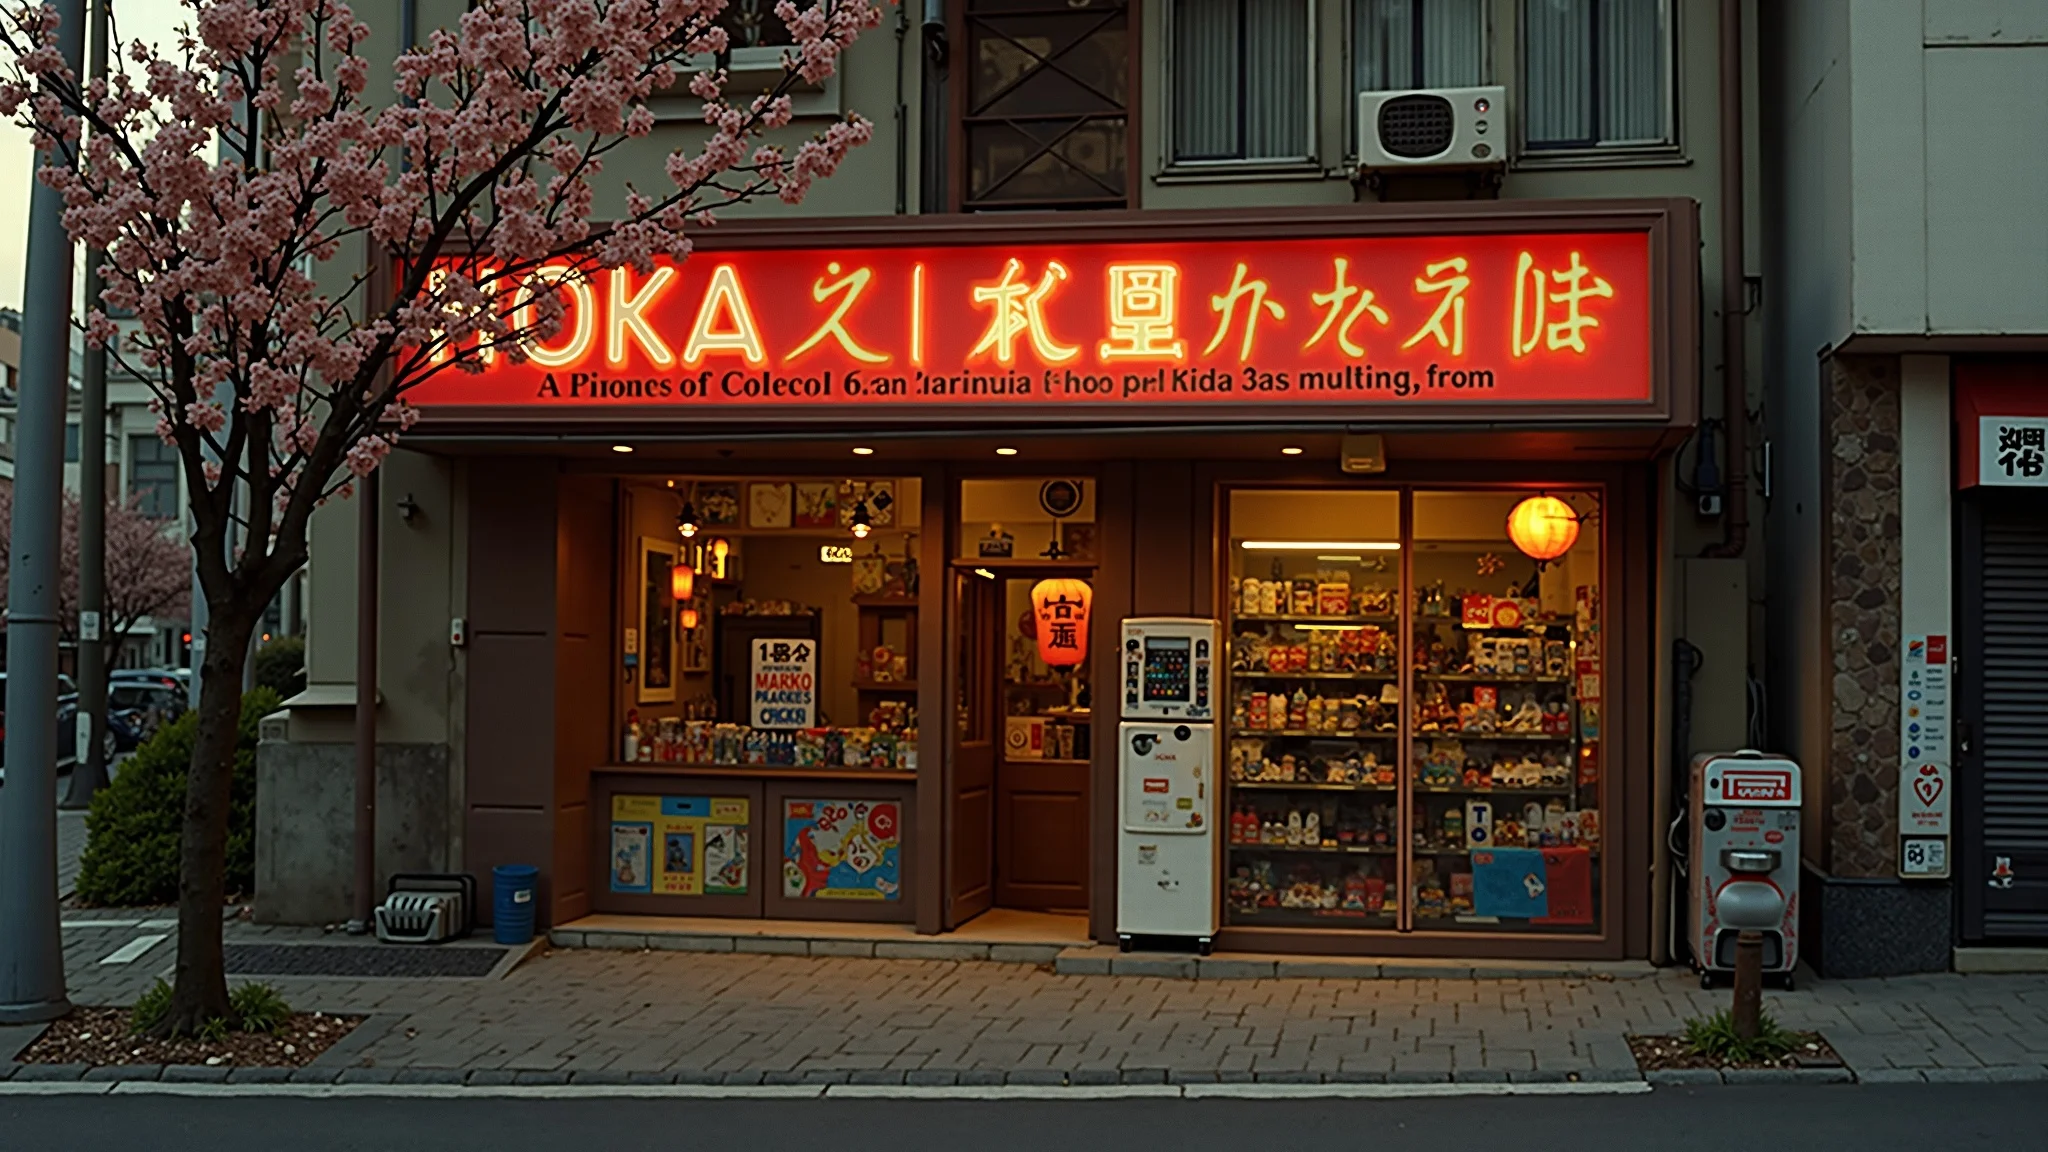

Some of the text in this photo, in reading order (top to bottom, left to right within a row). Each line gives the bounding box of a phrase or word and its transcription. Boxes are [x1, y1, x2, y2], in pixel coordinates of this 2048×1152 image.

[537, 374, 559, 397] A
[679, 372, 713, 397] of
[1172, 369, 1233, 392] Kida
[1242, 367, 1290, 391] 3as
[1299, 367, 1420, 397] multing,
[1427, 367, 1494, 390] from
